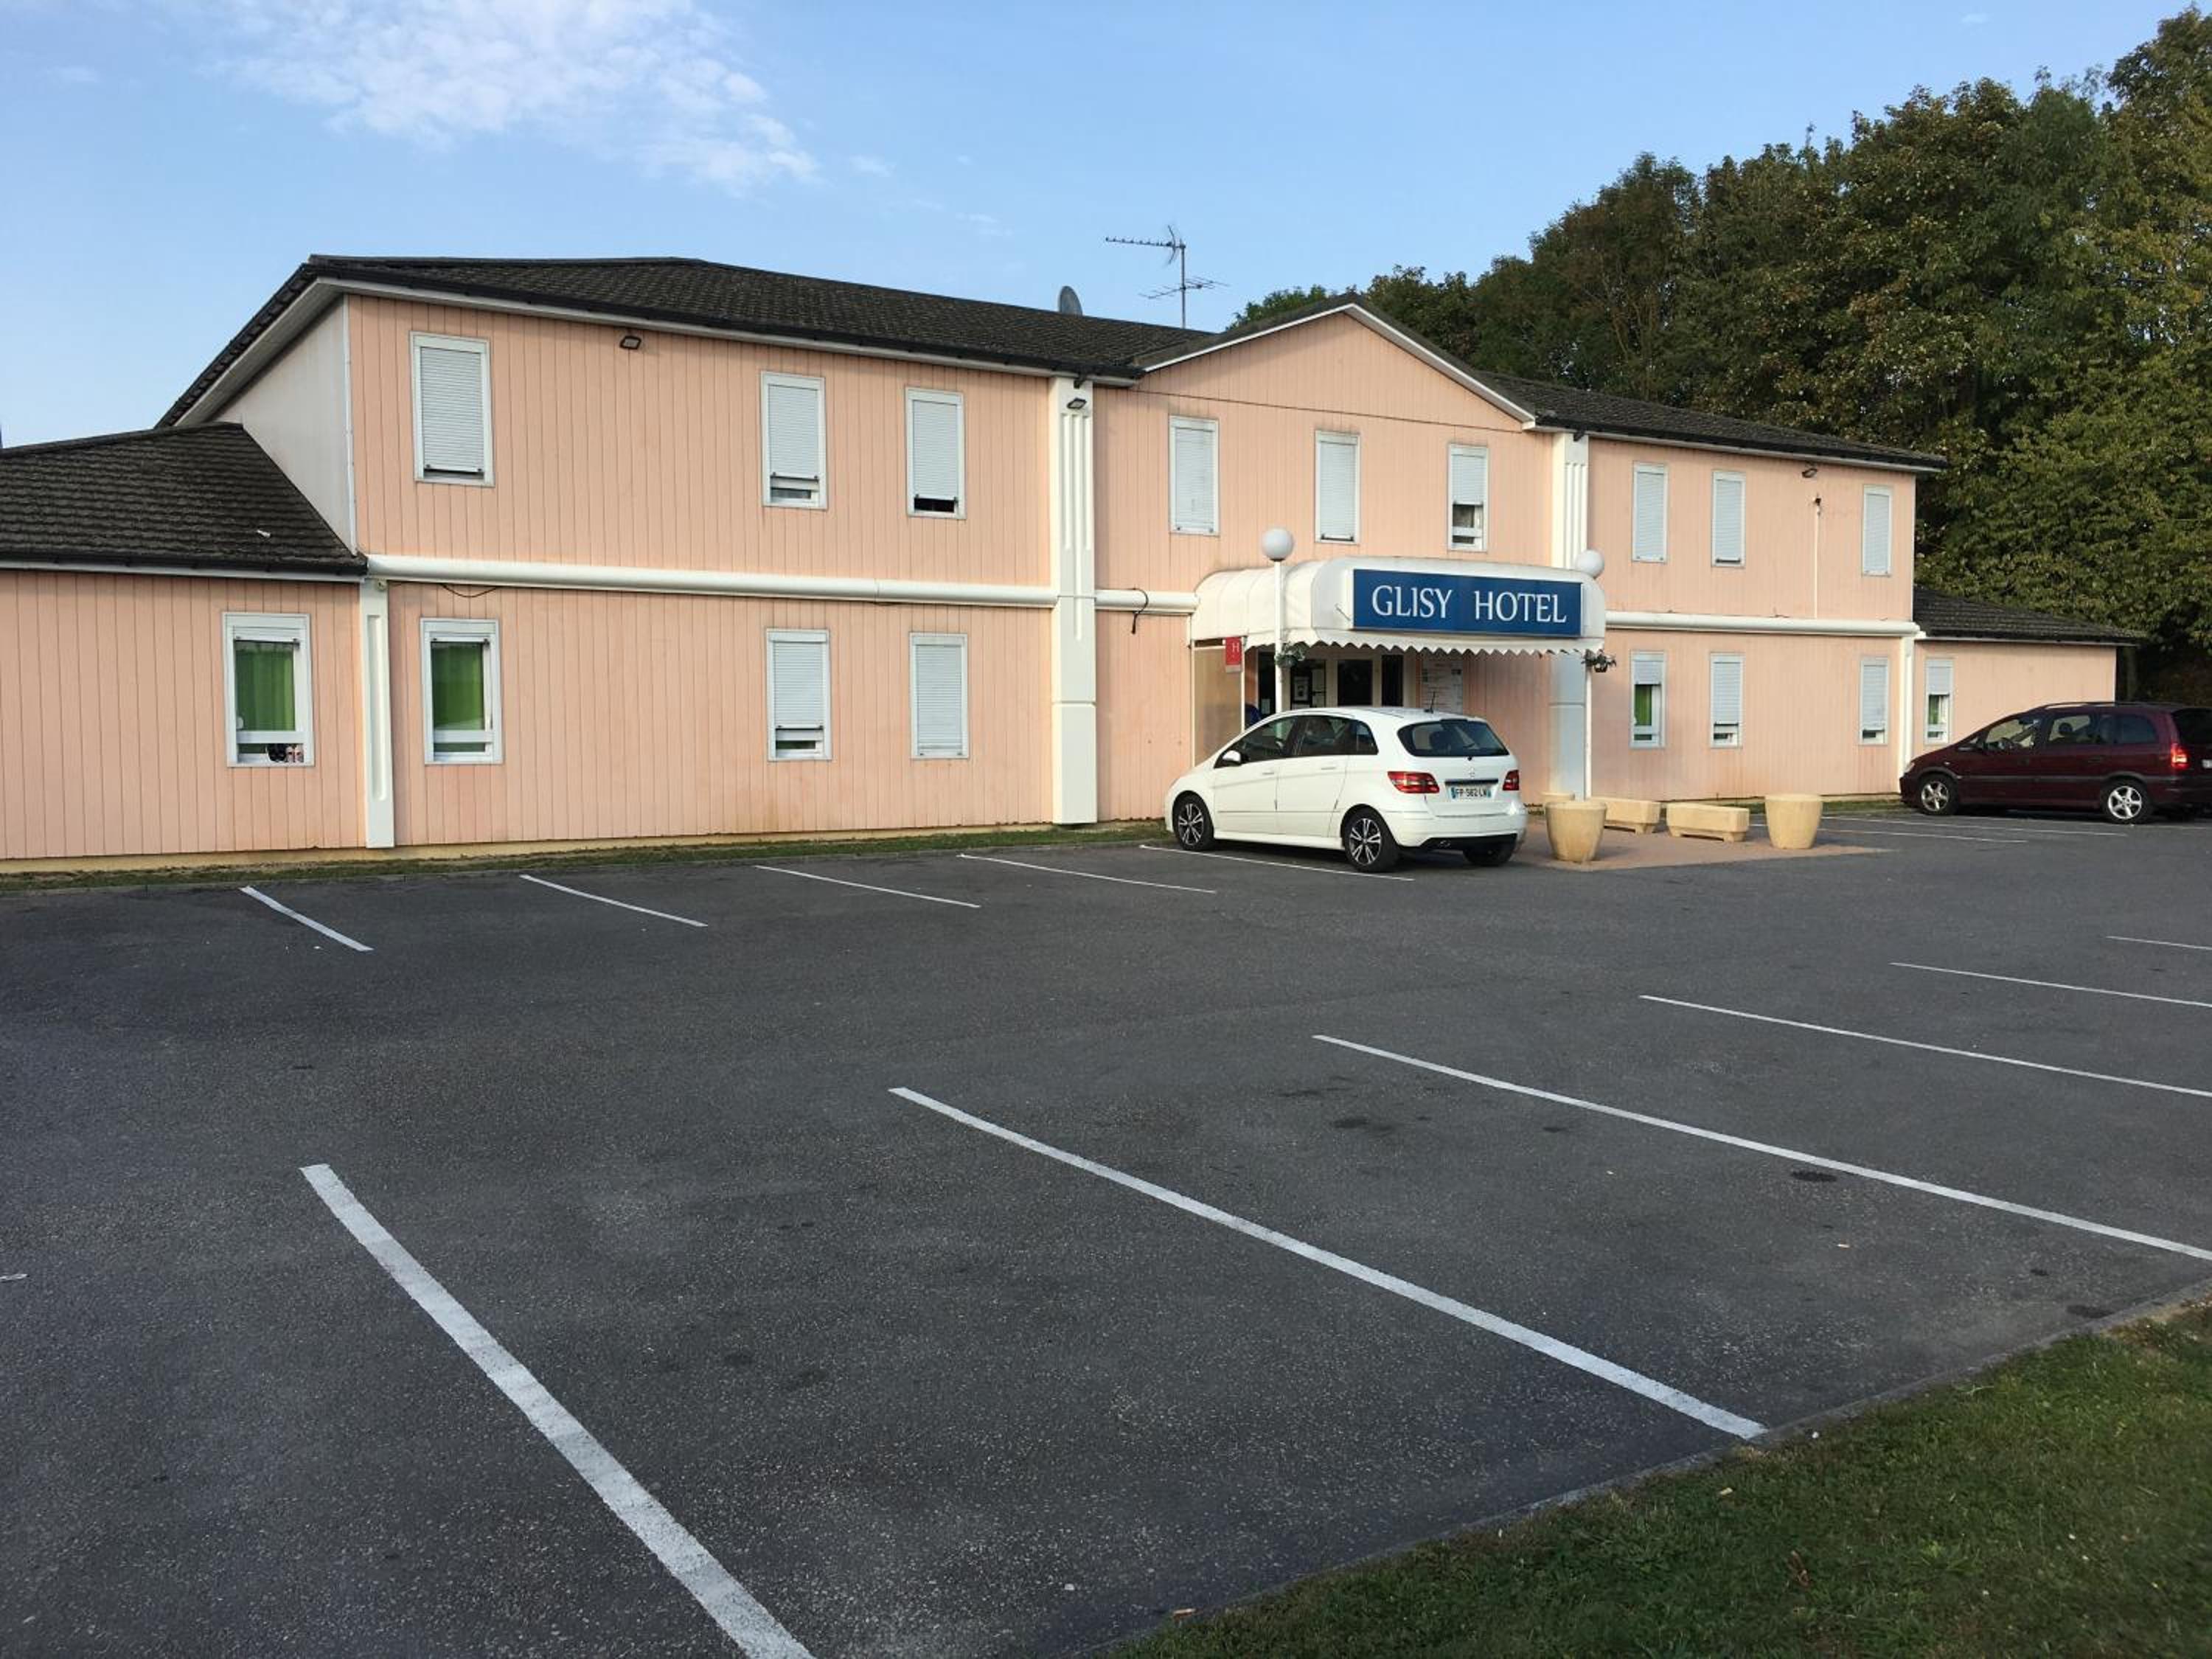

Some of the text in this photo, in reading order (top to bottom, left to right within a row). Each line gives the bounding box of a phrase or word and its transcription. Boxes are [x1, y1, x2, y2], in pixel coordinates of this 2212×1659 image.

[1372, 585, 1567, 623] GLISY HOTEL
[1232, 642, 1239, 653] H
